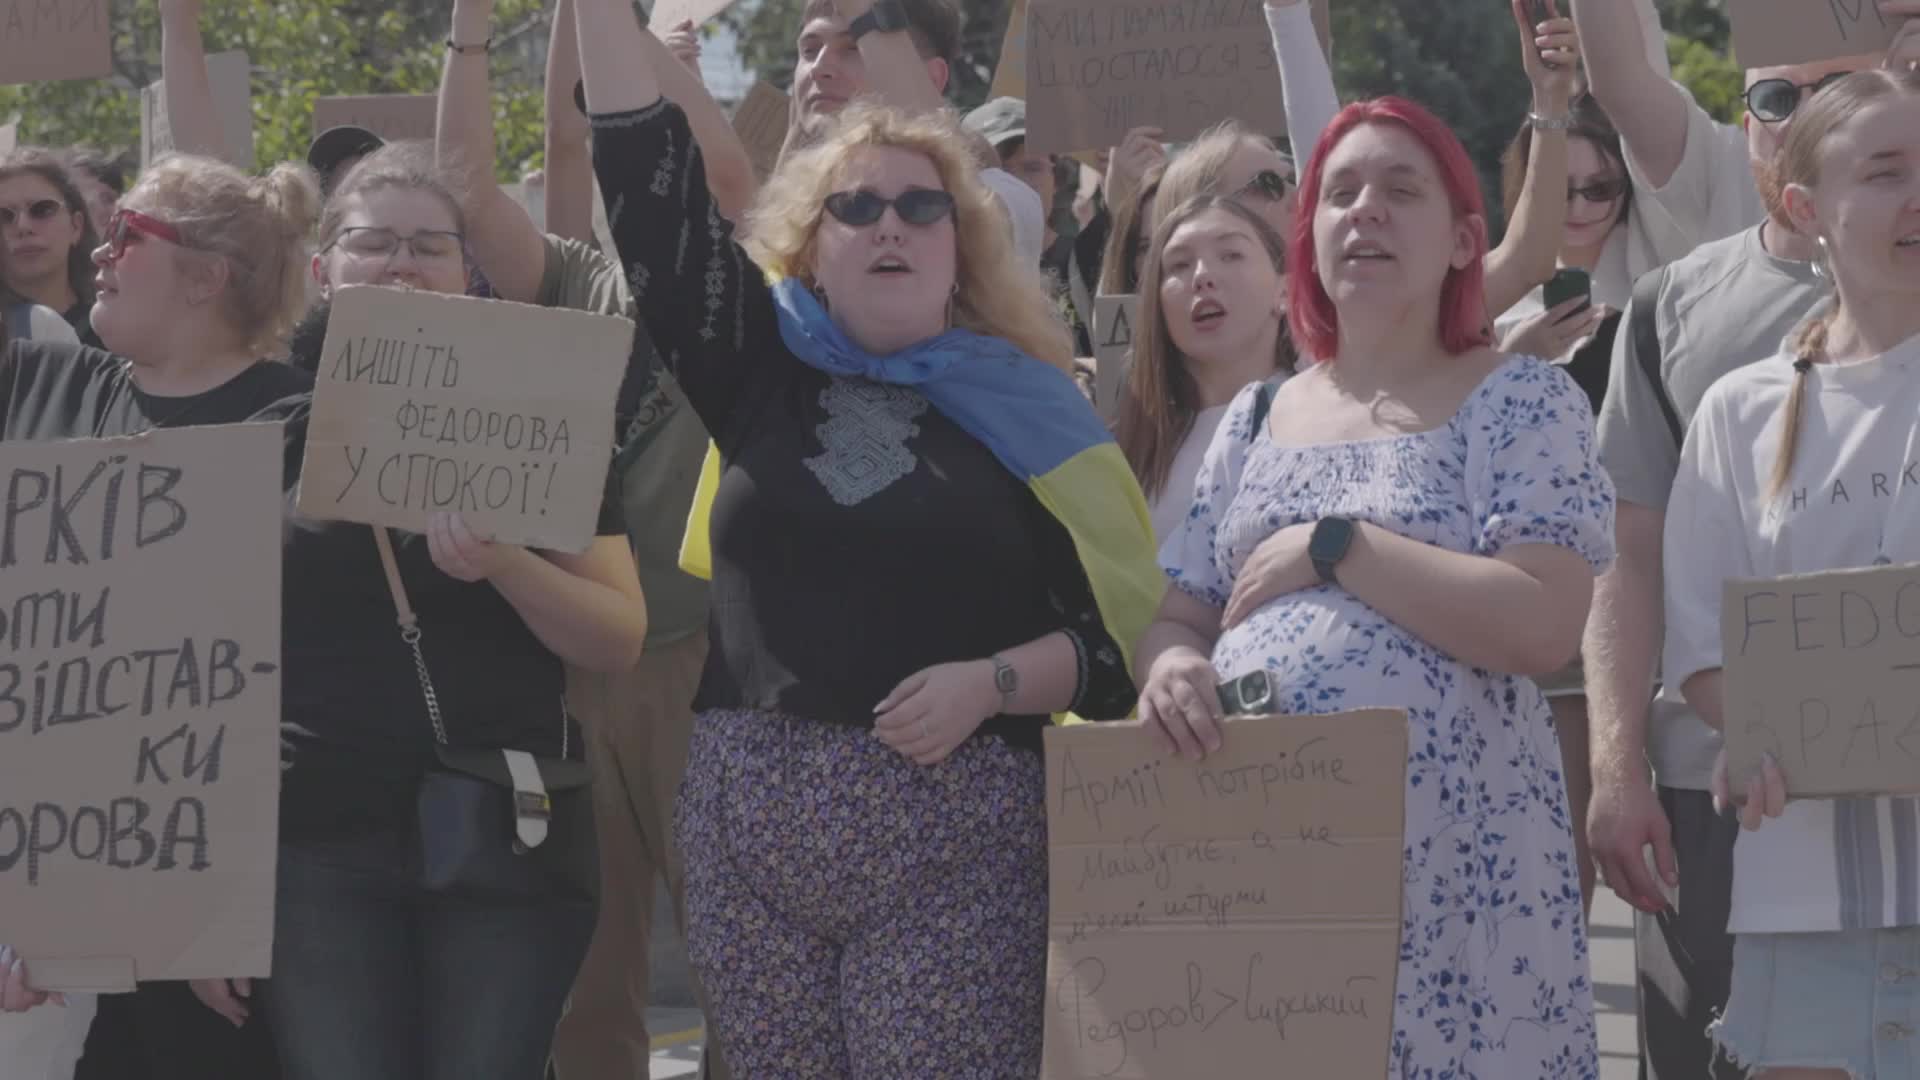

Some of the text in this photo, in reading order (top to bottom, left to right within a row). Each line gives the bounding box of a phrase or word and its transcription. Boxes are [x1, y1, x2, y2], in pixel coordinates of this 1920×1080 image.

[331, 327, 460, 389] ЛИШІТЬ
[396, 400, 570, 454] ФЕДОРОВА
[335, 446, 558, 516] У СПОКОЇ!
[134, 723, 226, 785] КИ
[1059, 745, 1166, 829] Армії
[1299, 823, 1345, 850] не
